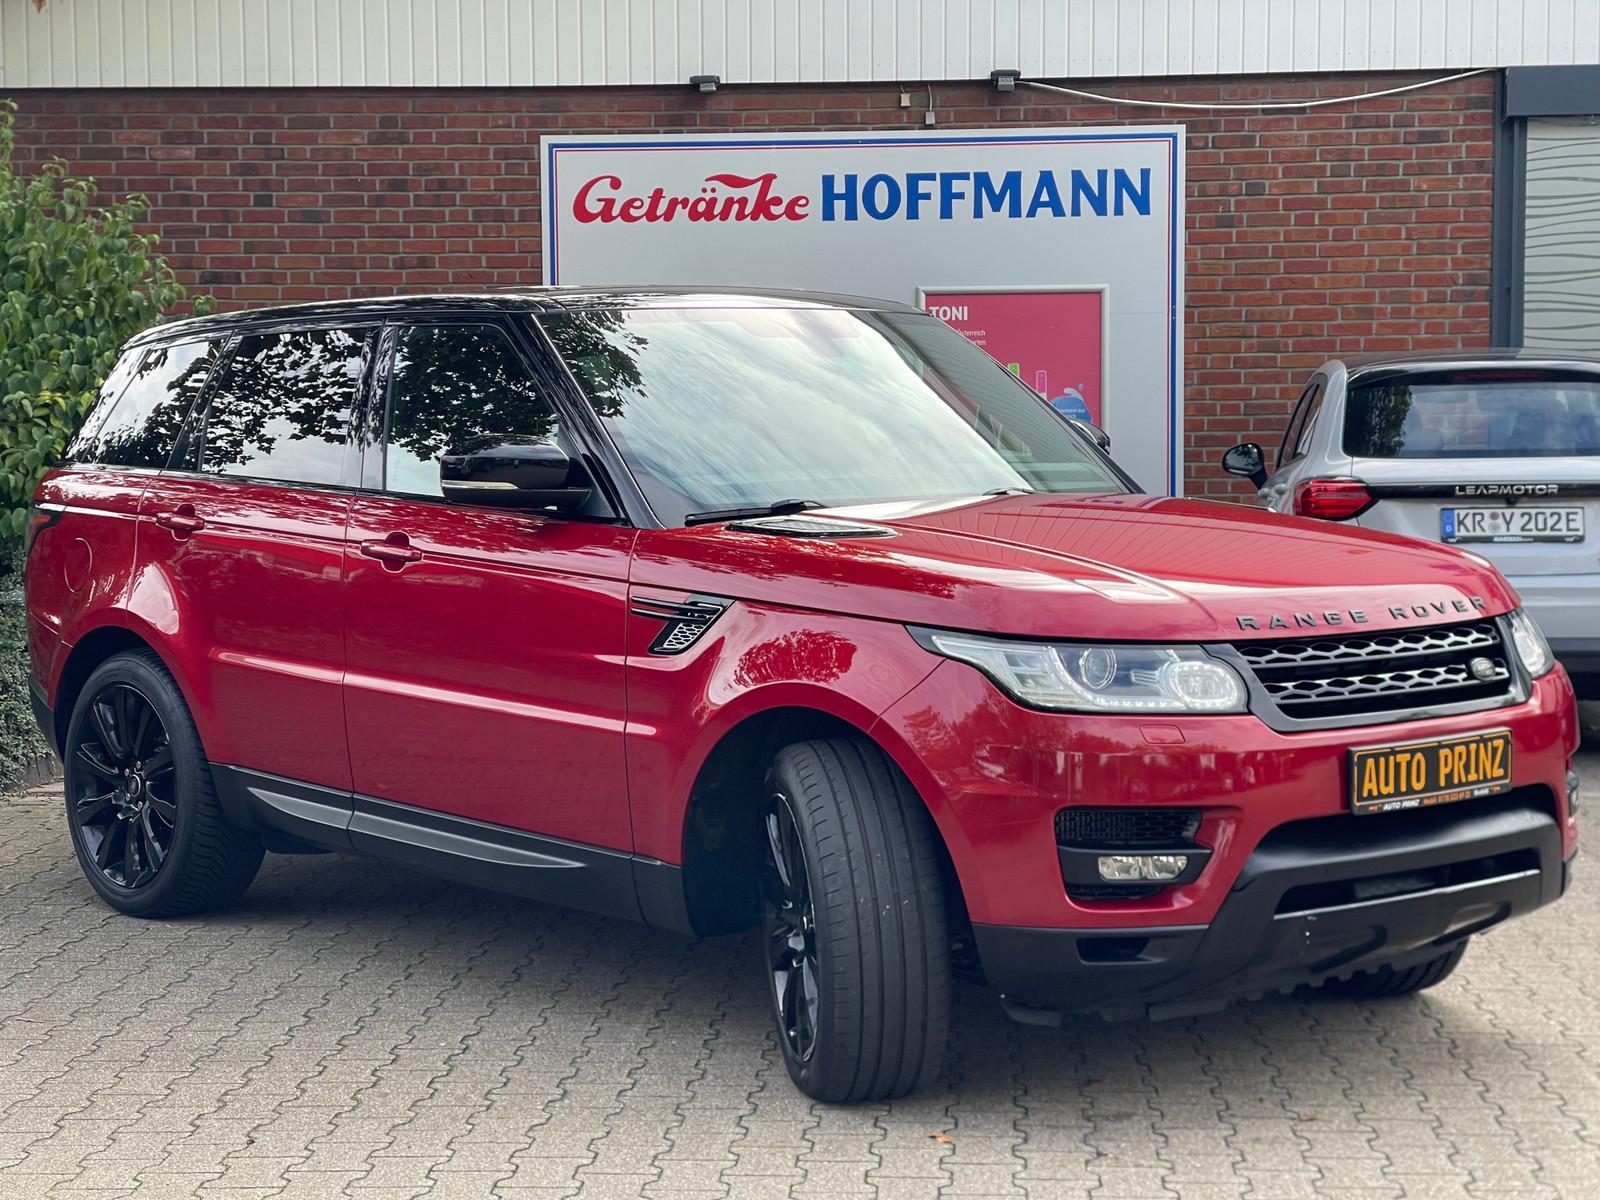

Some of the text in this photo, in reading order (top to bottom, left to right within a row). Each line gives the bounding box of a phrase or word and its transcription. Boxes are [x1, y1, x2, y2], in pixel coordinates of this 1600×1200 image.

[573, 167, 1152, 224] Getränke HOFFMANN
[929, 305, 969, 321] TONI
[1455, 484, 1559, 496] LEAPMOTOR
[1456, 511, 1486, 533] KR
[1501, 511, 1515, 532] Y
[1520, 511, 1580, 532] 202E
[1236, 596, 1486, 631] RANGE ROVER
[1362, 738, 1505, 798] AUTO PRINZ
[1382, 799, 1421, 811] AUTO PRINZ
